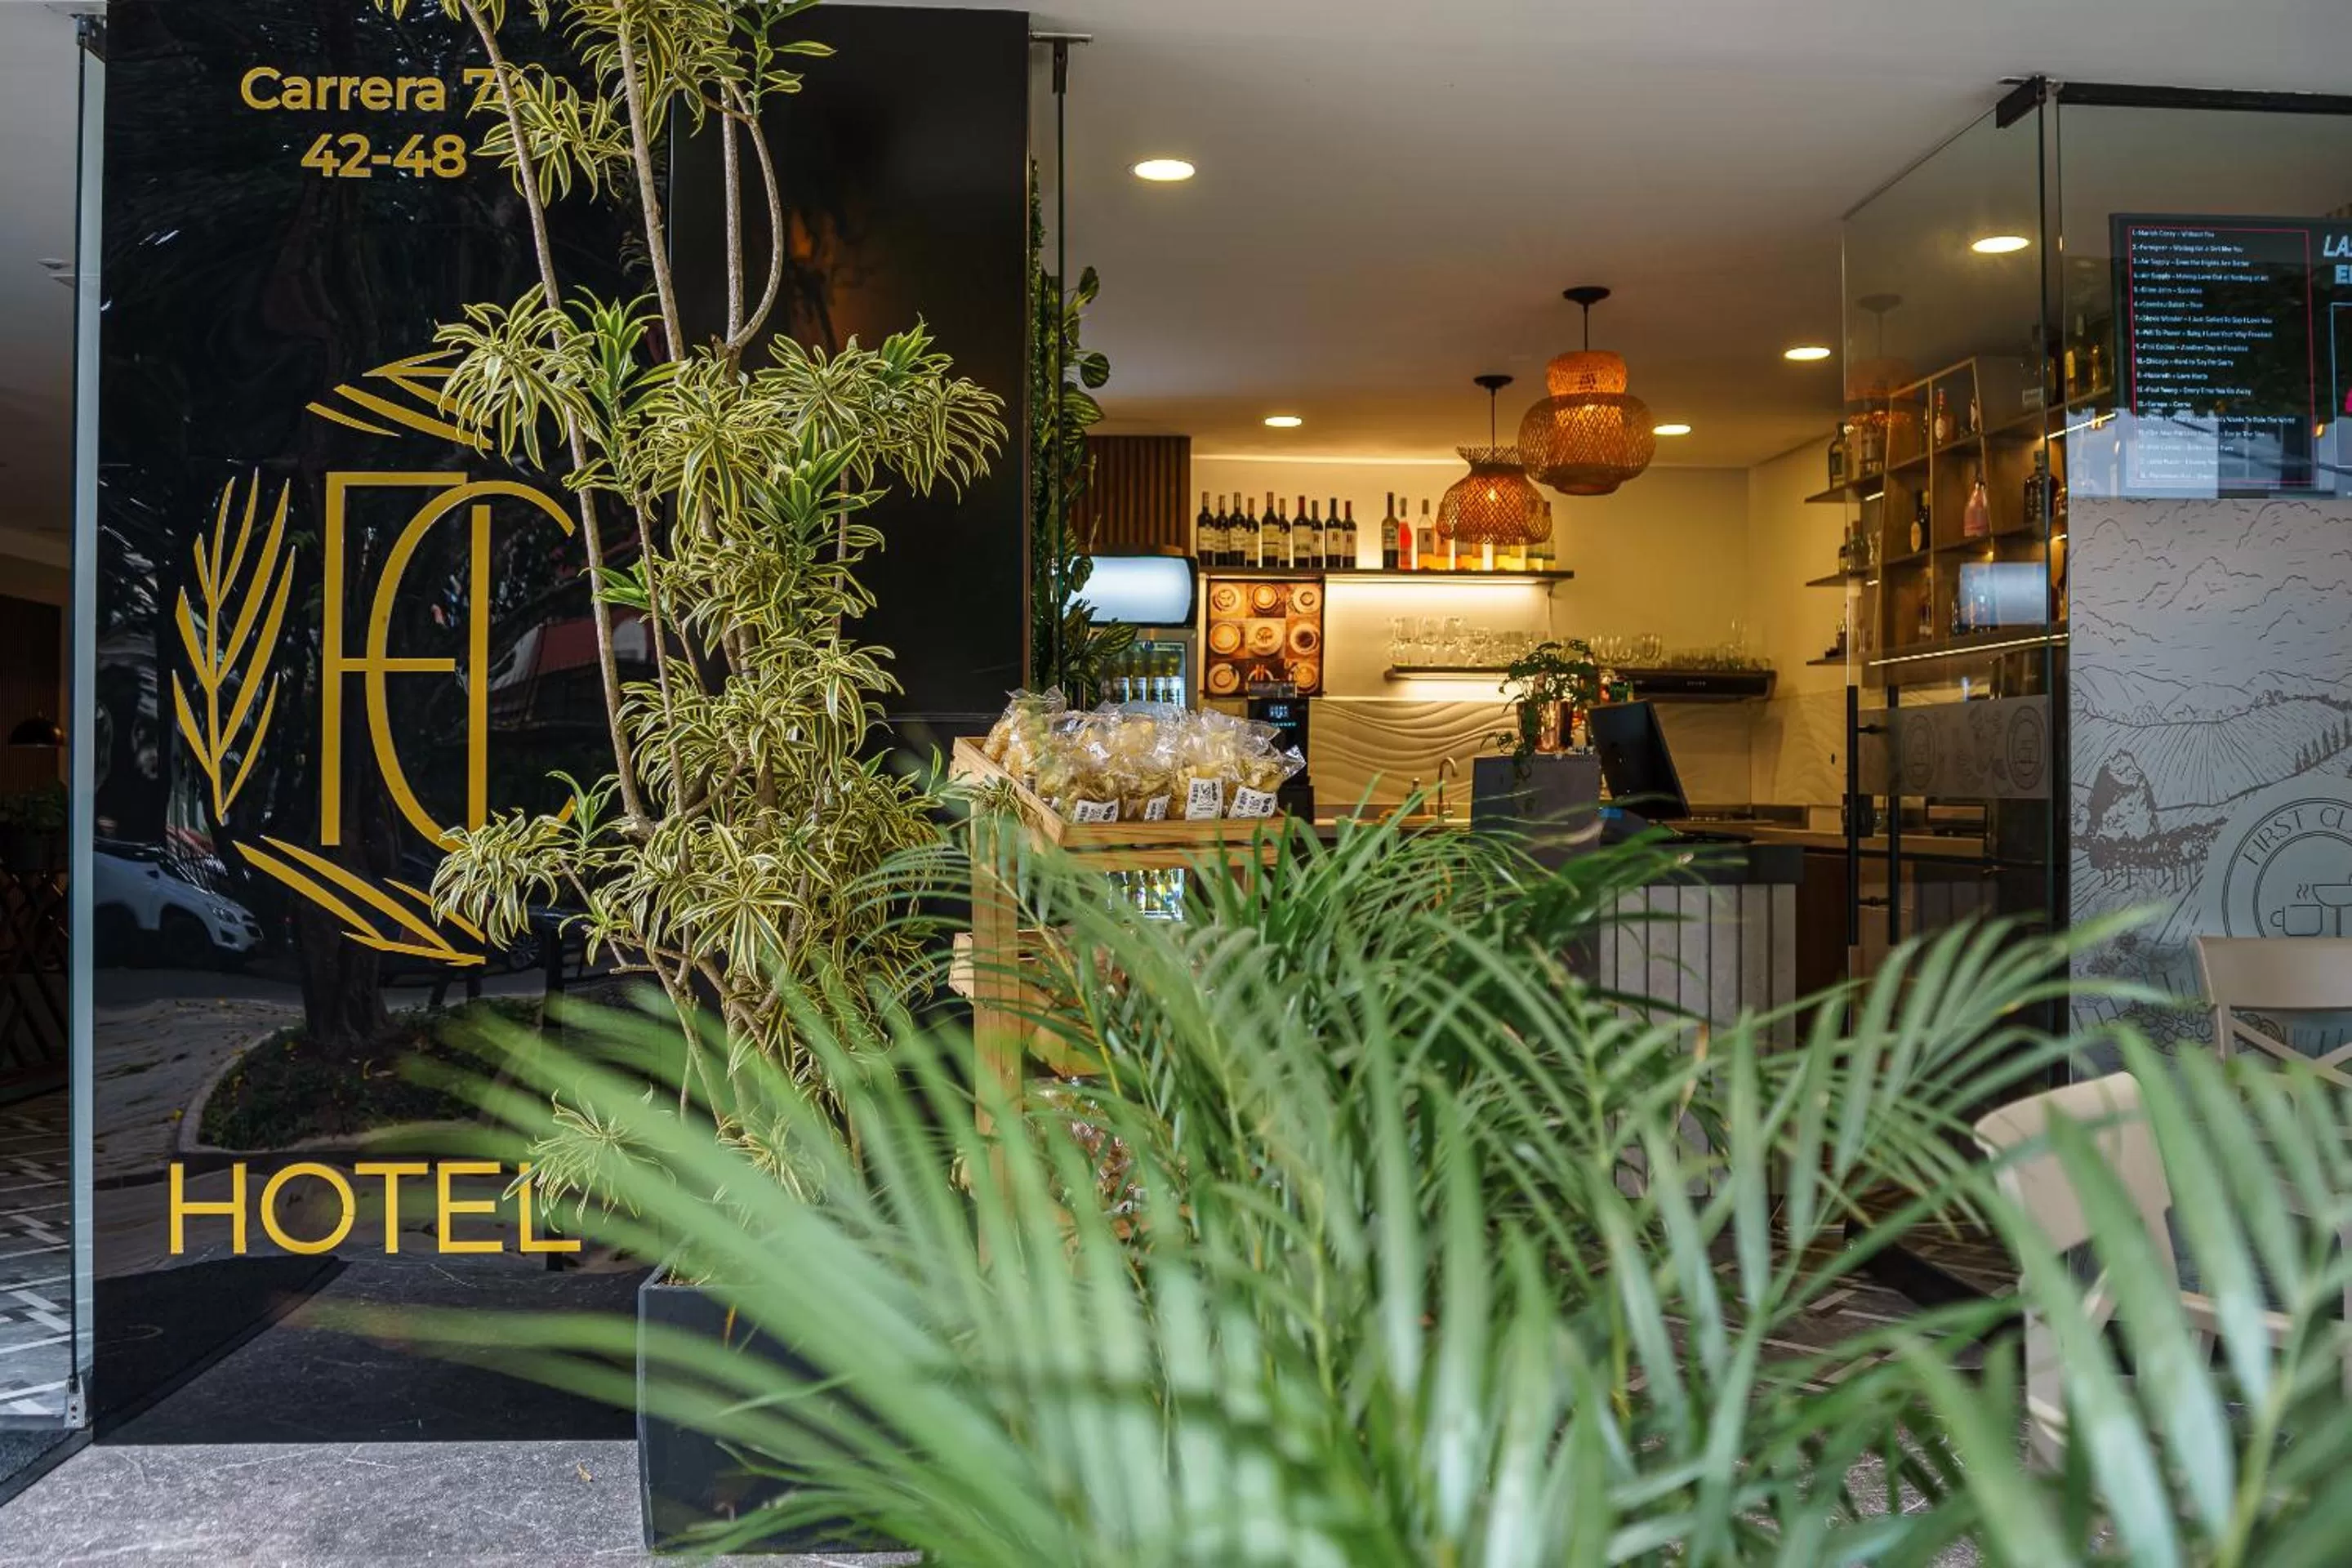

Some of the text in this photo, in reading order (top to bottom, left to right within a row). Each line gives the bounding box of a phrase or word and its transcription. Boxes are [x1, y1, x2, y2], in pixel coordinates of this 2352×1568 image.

[240, 66, 446, 111] Carrera
[301, 133, 467, 178] 42-48
[2323, 235, 2352, 257] LA
[2243, 808, 2303, 866] FIRST
[169, 1161, 581, 1255] HOTEL
